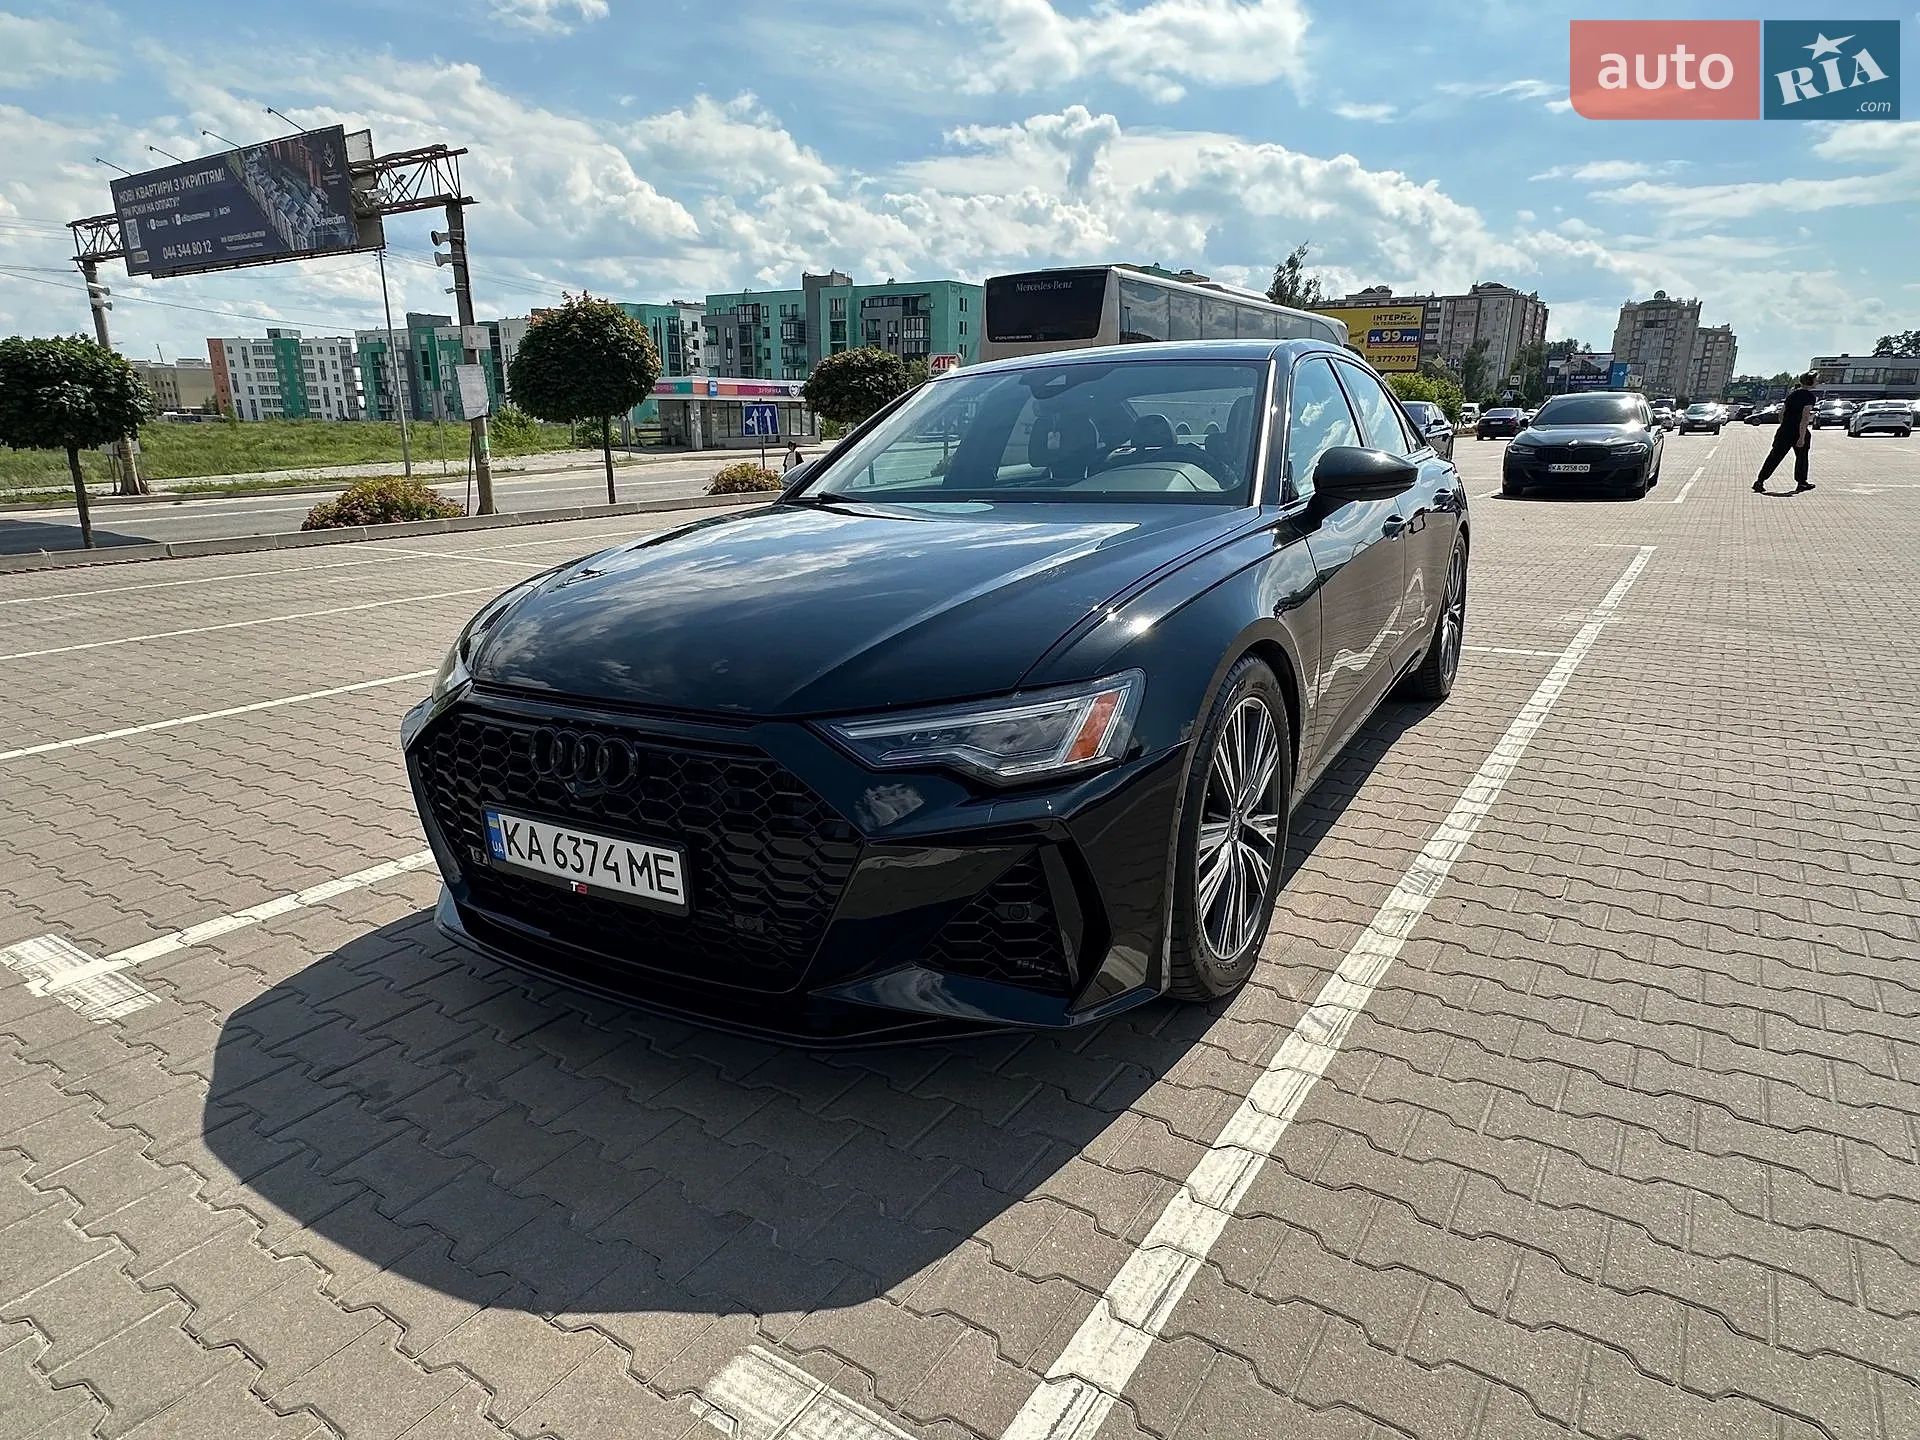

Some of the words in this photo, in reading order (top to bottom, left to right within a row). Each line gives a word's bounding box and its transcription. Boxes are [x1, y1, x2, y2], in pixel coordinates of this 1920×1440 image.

[135, 180, 173, 199] КВАРТИРИ
[180, 168, 226, 190] УКРИТТЯМ!
[162, 246, 176, 260] 044
[176, 243, 191, 257] 344
[191, 241, 202, 255] 80
[202, 239, 212, 253] 12
[1016, 280, 1073, 293] Mercedes-Benz
[1382, 330, 1401, 342] 99
[491, 839, 505, 854] UA
[503, 819, 547, 865] KA
[553, 833, 621, 884] 6374
[626, 848, 680, 897] ME
